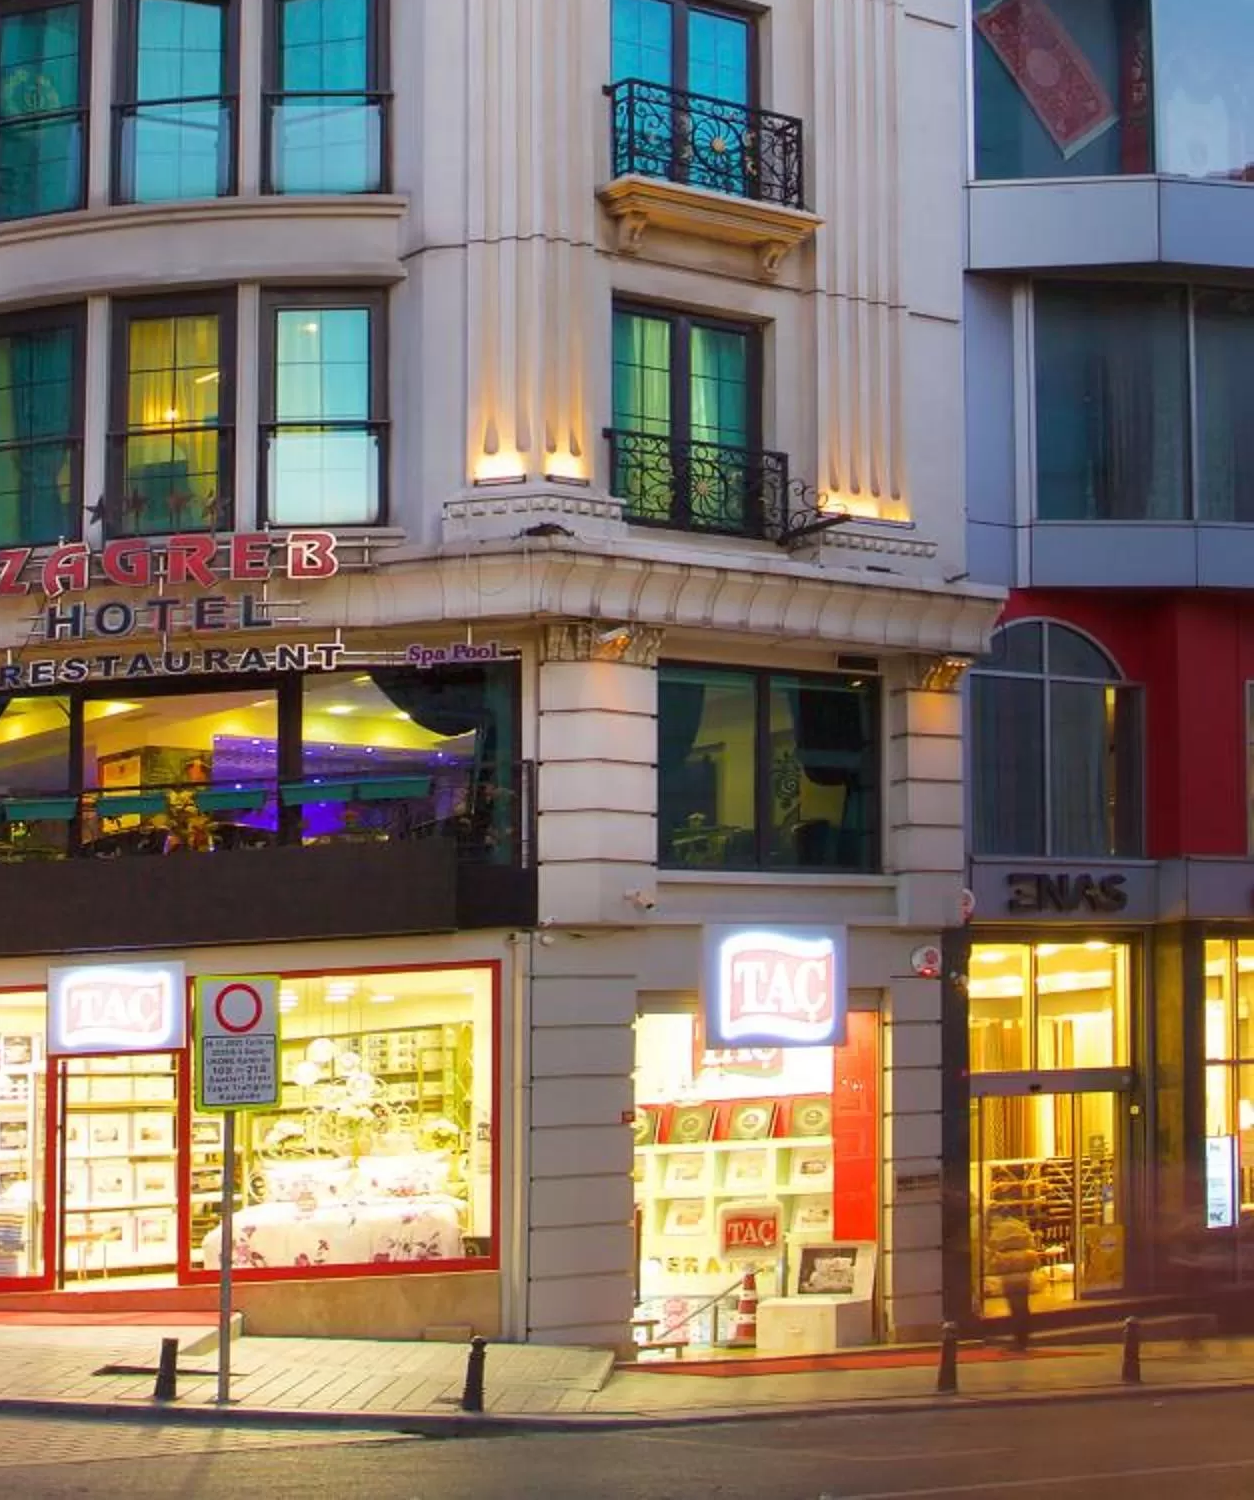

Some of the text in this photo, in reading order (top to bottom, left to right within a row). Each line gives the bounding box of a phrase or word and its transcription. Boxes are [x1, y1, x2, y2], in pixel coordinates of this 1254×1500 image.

[46, 594, 273, 640] HOTEL
[408, 640, 499, 667] Spa Pool
[732, 960, 828, 1022] TAÇ
[728, 1219, 775, 1246] TAÇ
